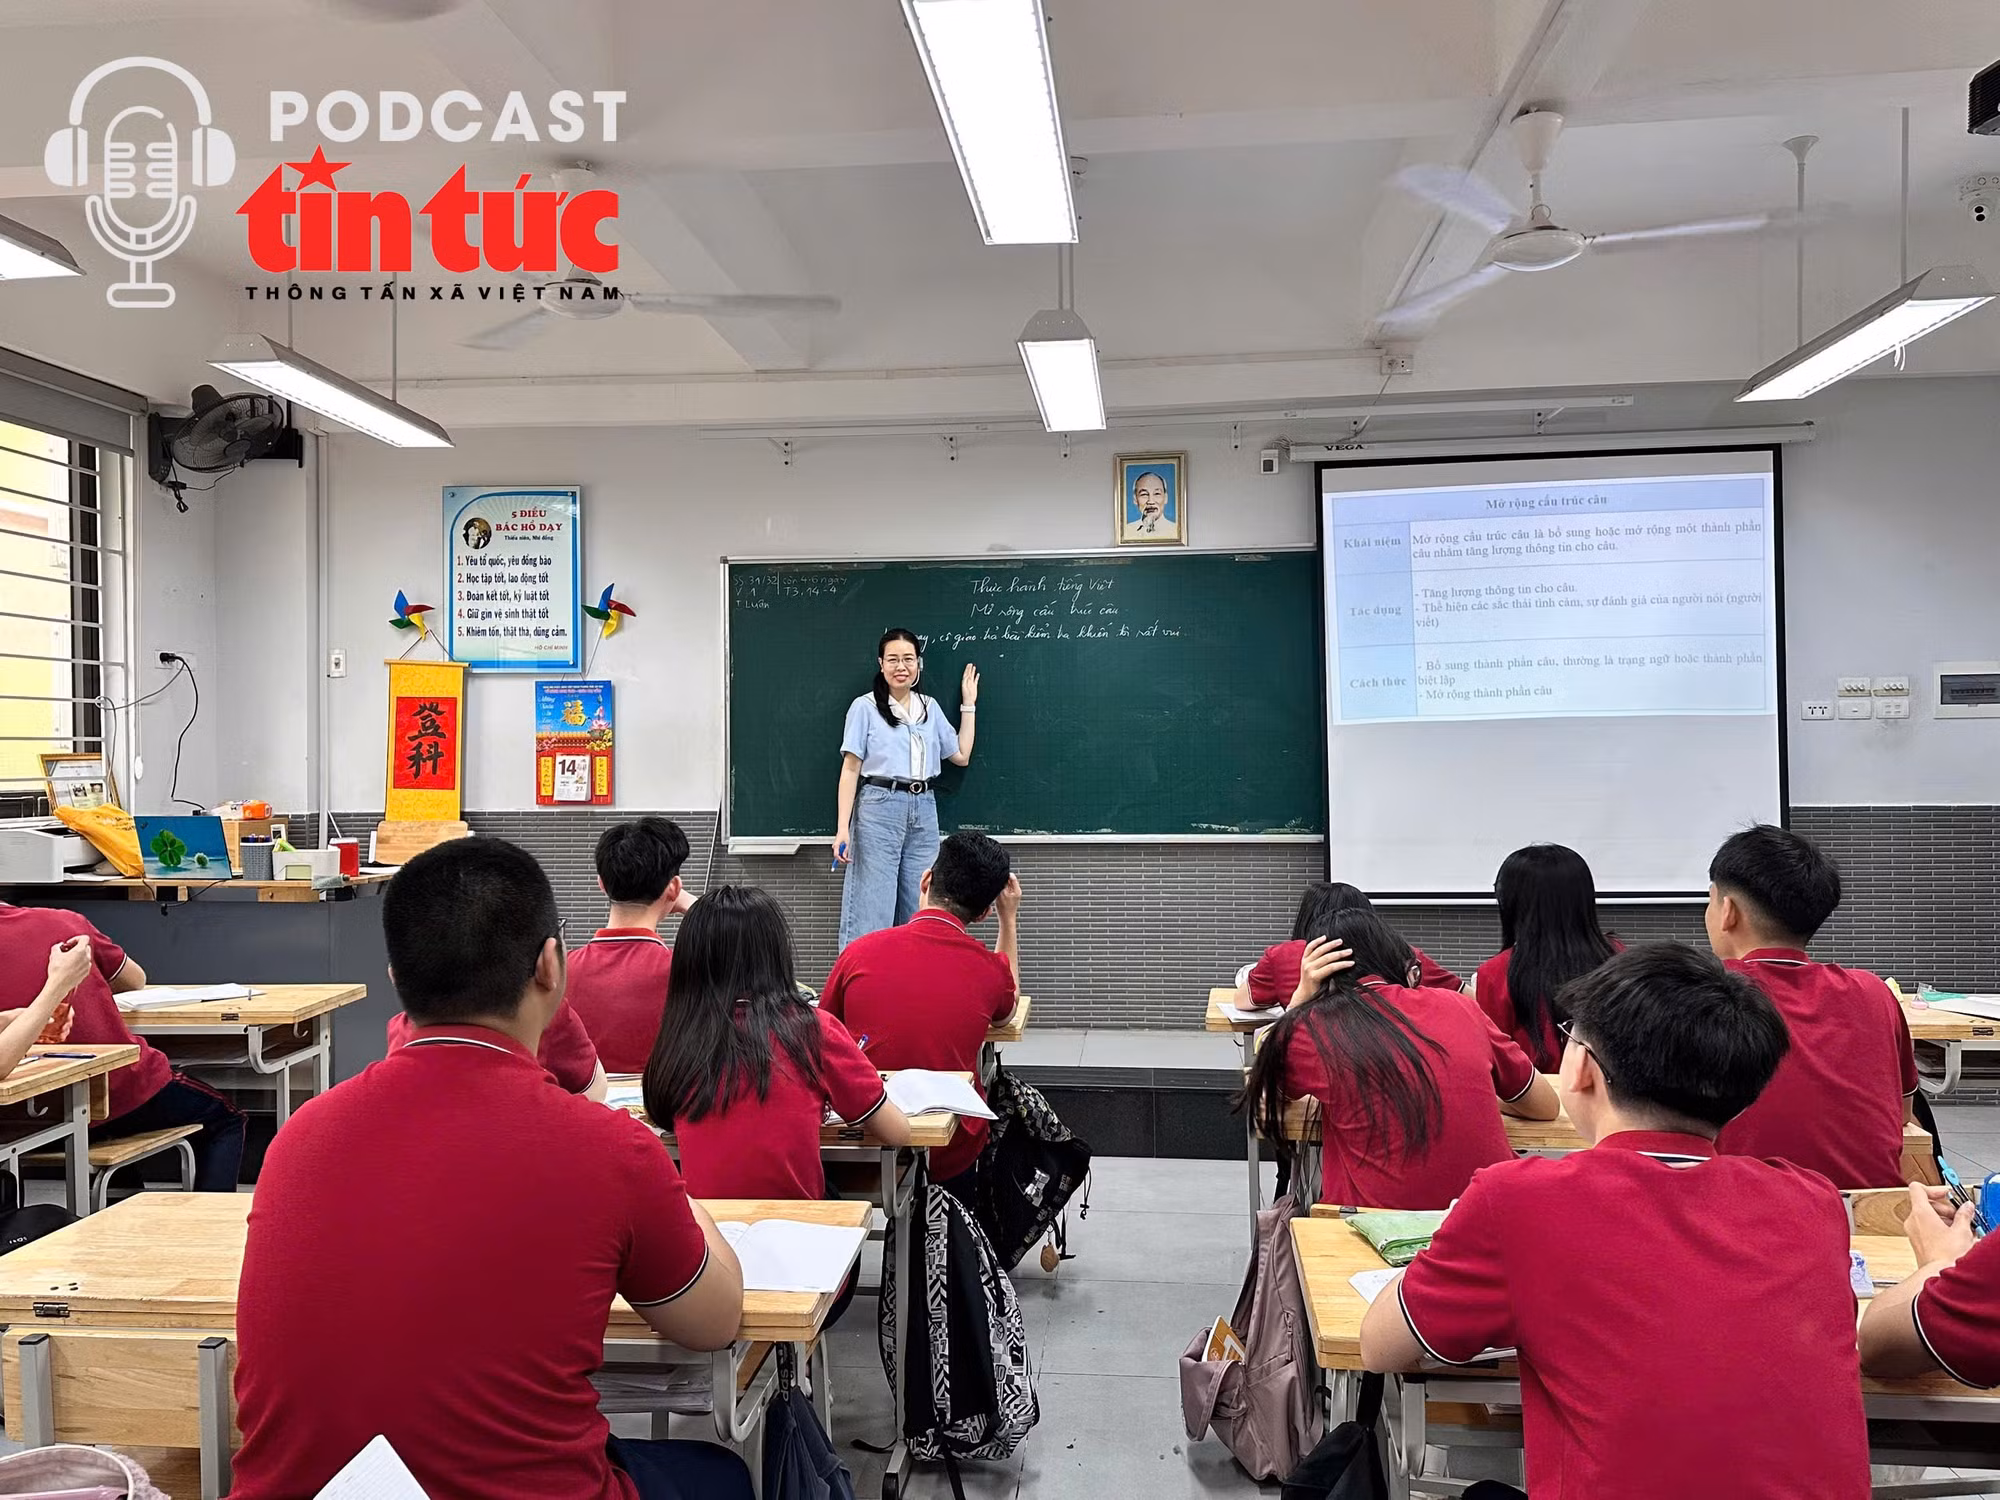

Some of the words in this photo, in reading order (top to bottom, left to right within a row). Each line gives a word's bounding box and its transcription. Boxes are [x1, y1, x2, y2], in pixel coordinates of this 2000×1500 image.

[1561, 495, 1584, 506] trúc
[1588, 494, 1608, 505] câu
[512, 511, 517, 519] 5
[520, 506, 547, 518] ĐIỀU
[495, 521, 518, 531] BÁC
[520, 520, 536, 531] HỒ
[539, 523, 563, 533] DẠY
[1486, 530, 1507, 541] trúc
[1511, 529, 1530, 540] câu
[1534, 528, 1544, 539] là
[1566, 528, 1591, 539] sung
[1412, 548, 1431, 559] câu
[1491, 545, 1522, 557] lượng
[1525, 542, 1555, 554] thông
[1558, 542, 1572, 552] tin
[1575, 541, 1595, 552] cho
[457, 556, 464, 566] 1.
[465, 555, 478, 566] Yêu
[507, 555, 519, 568] yêu
[457, 573, 464, 584] 2.
[466, 573, 479, 586] Học
[508, 573, 519, 584] lao
[520, 573, 537, 586] động
[539, 571, 549, 583] tốt
[970, 576, 1003, 597] Thực
[1518, 584, 1532, 594] tin
[1534, 583, 1554, 594] cho
[457, 590, 464, 601] 3.
[486, 589, 497, 601] kết
[539, 589, 550, 601] tốt
[458, 608, 465, 619] 4.
[467, 608, 480, 619] Giữ
[505, 608, 520, 619] sinh
[538, 607, 549, 619] tốt
[1099, 602, 1119, 616] câu
[457, 626, 465, 637] 5.
[466, 626, 487, 637] Khiêm
[1445, 661, 1470, 672] sung
[558, 759, 577, 776] 14
